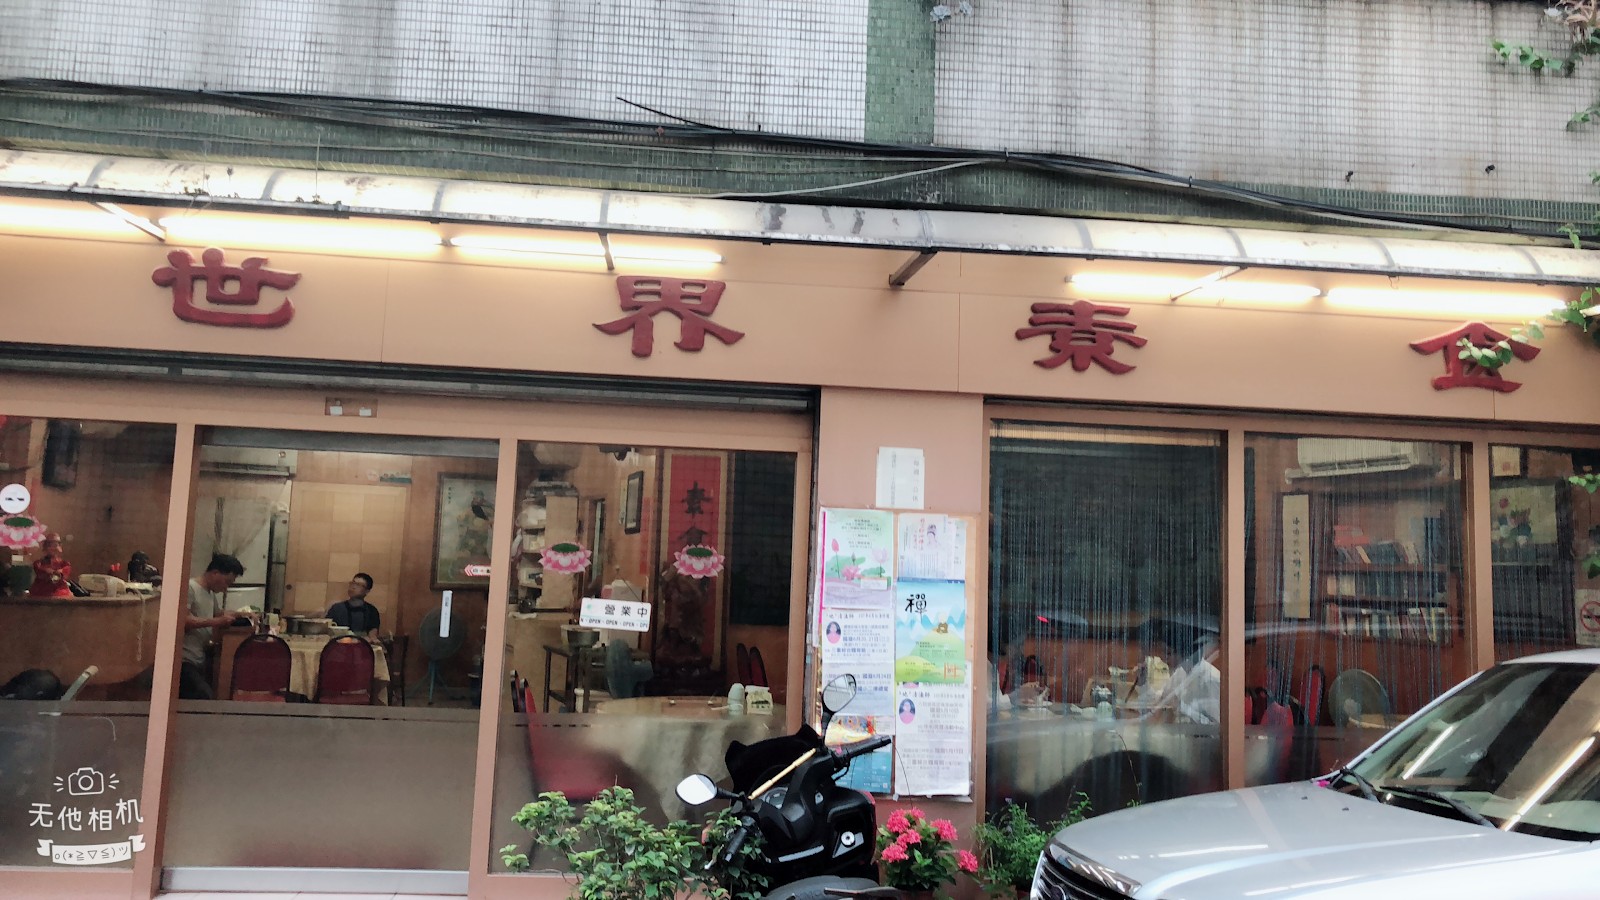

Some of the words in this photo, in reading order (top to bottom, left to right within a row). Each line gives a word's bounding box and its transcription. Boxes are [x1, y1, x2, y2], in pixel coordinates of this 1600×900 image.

[604, 604, 648, 618] 營業中
[905, 593, 928, 613] 禪
